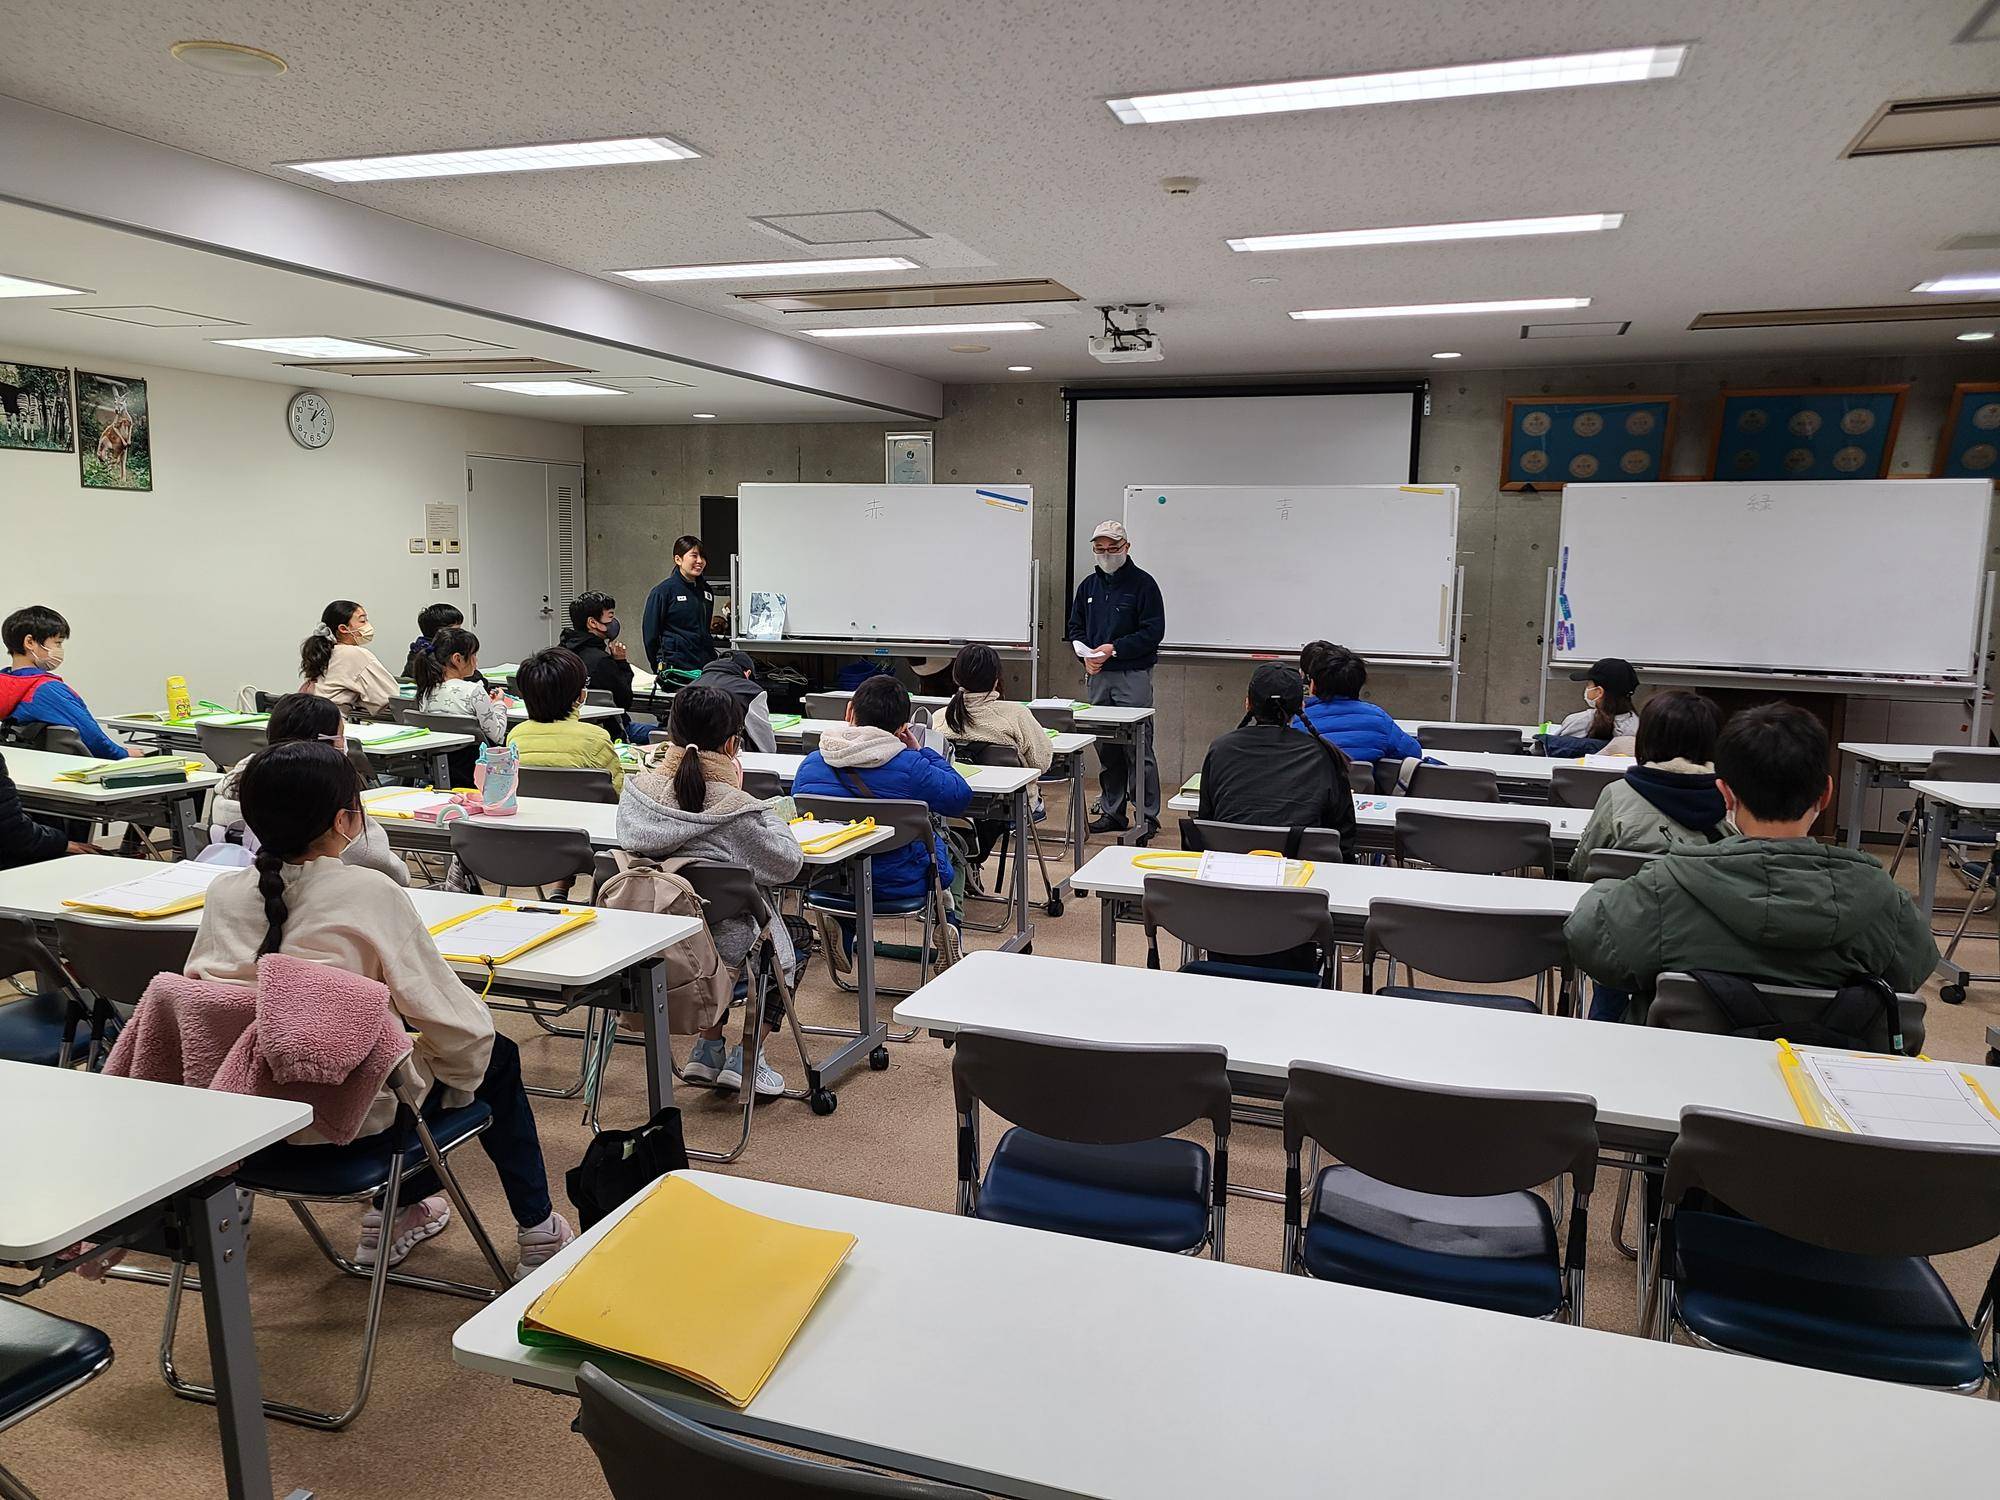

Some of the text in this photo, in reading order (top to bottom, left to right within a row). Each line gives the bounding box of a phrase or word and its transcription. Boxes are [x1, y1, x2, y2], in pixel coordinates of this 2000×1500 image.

[864, 497, 885, 520] 赤
[1276, 496, 1294, 520] 青
[1746, 493, 1775, 512] 緑
